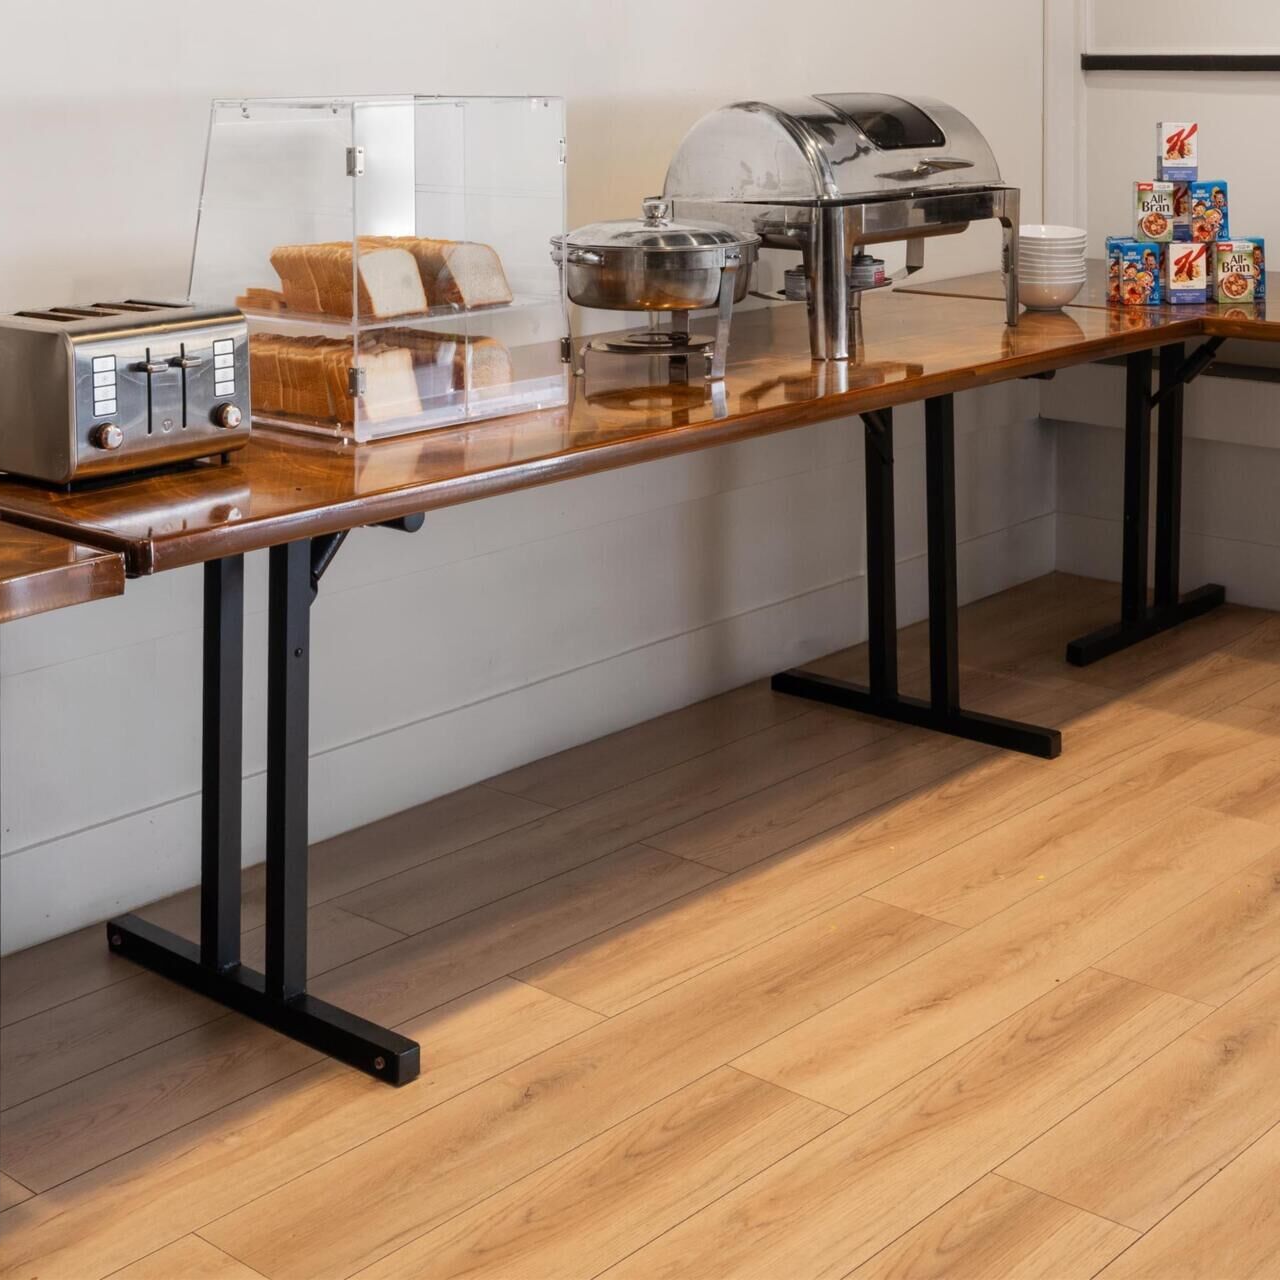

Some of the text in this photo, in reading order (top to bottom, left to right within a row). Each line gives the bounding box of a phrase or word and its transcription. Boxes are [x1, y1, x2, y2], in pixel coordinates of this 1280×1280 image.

[1150, 194, 1167, 204] All-
[1142, 201, 1170, 212] Bran
[1230, 255, 1247, 265] All-
[1222, 262, 1250, 273] Bran
